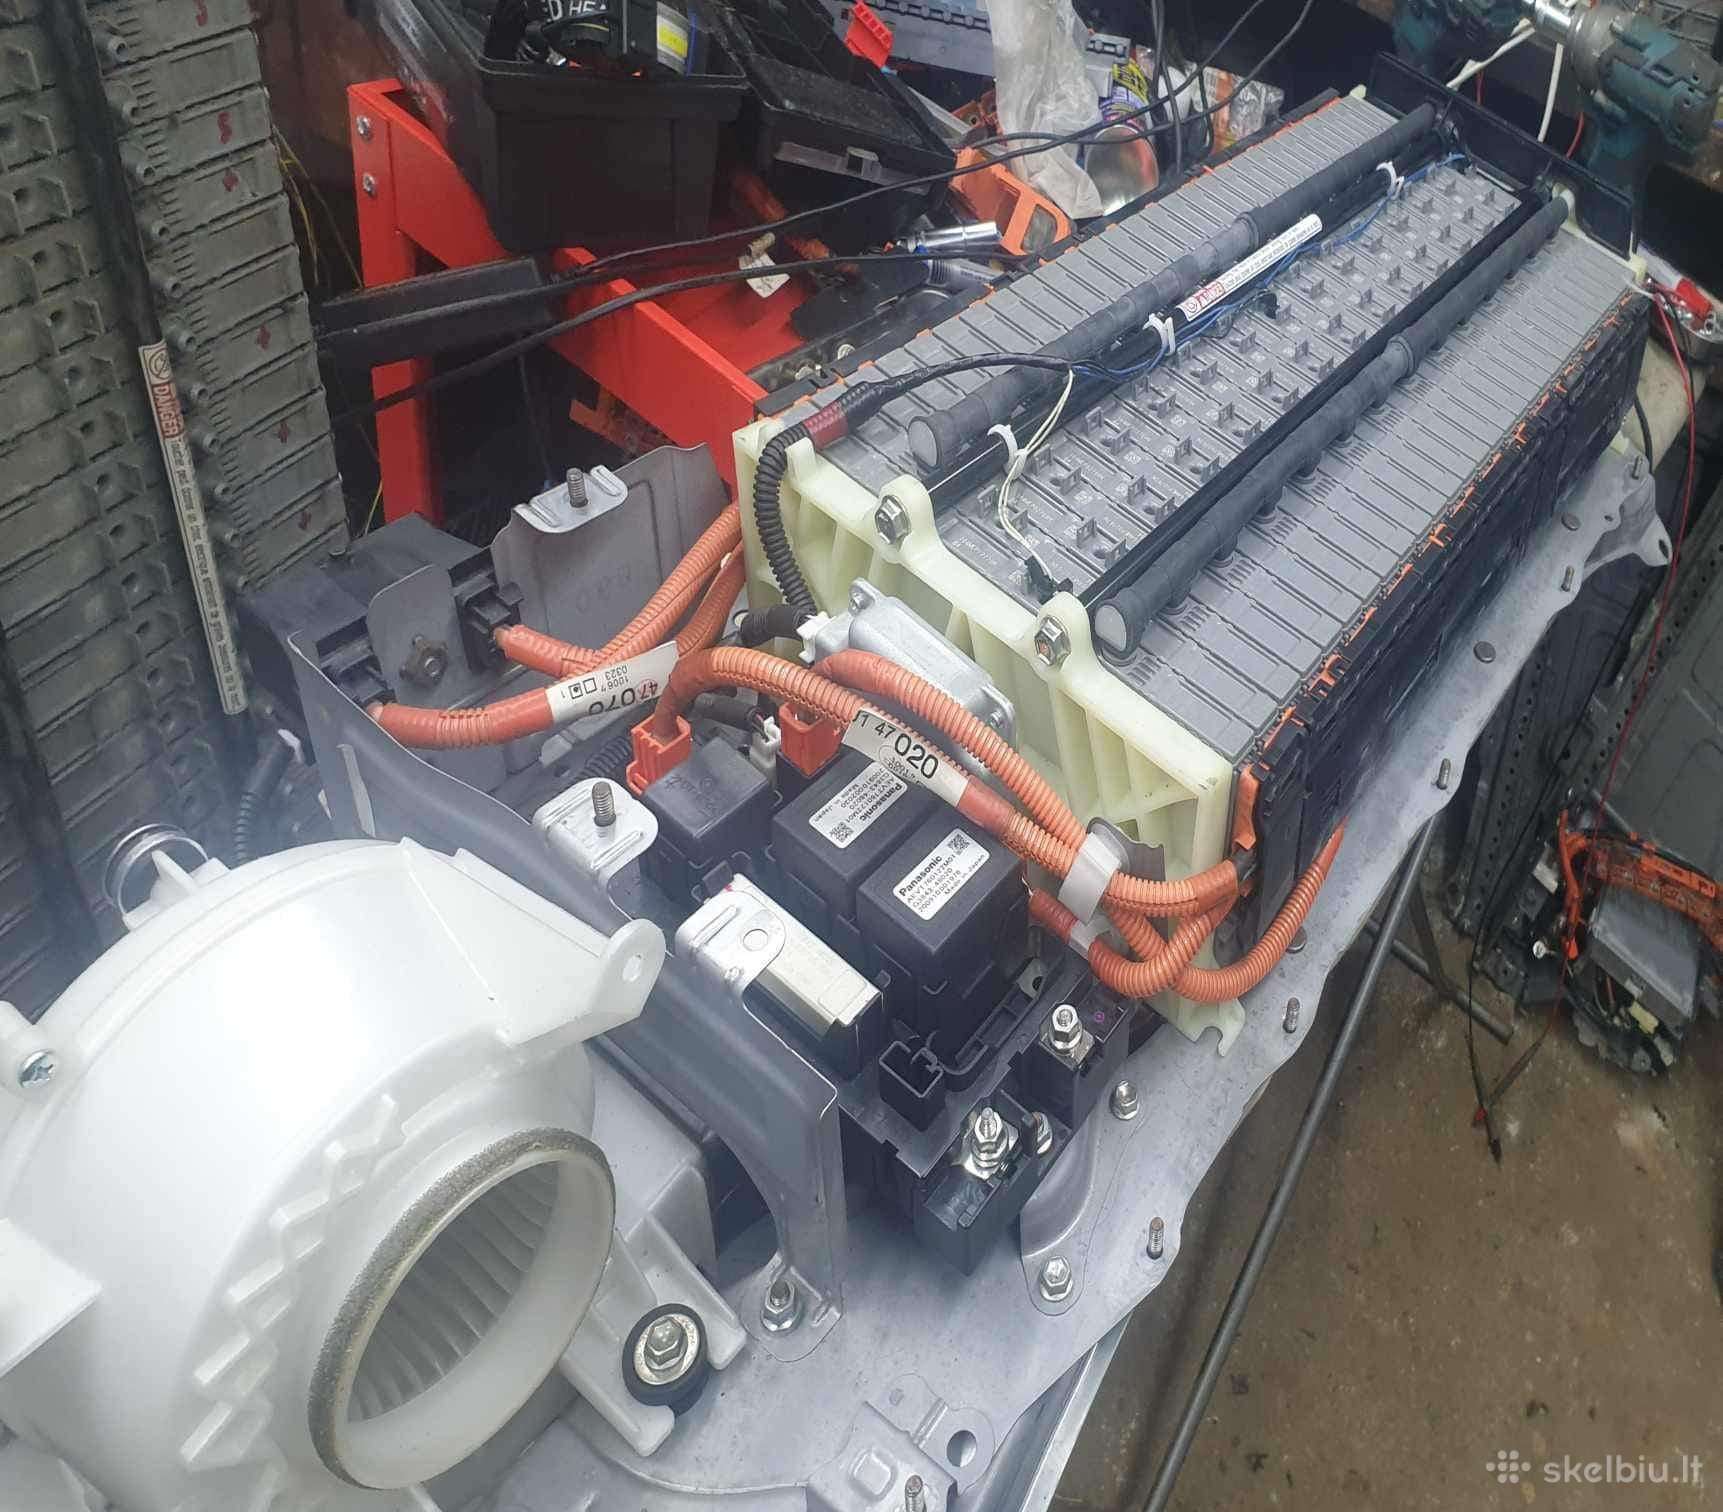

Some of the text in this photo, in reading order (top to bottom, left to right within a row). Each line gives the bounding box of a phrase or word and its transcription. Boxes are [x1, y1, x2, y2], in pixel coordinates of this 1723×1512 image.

[154, 384, 179, 436] DANGER
[875, 722, 896, 739] 47
[894, 733, 939, 779] 020
[859, 782, 903, 821] Panasonic
[898, 855, 943, 897] Panasonic
